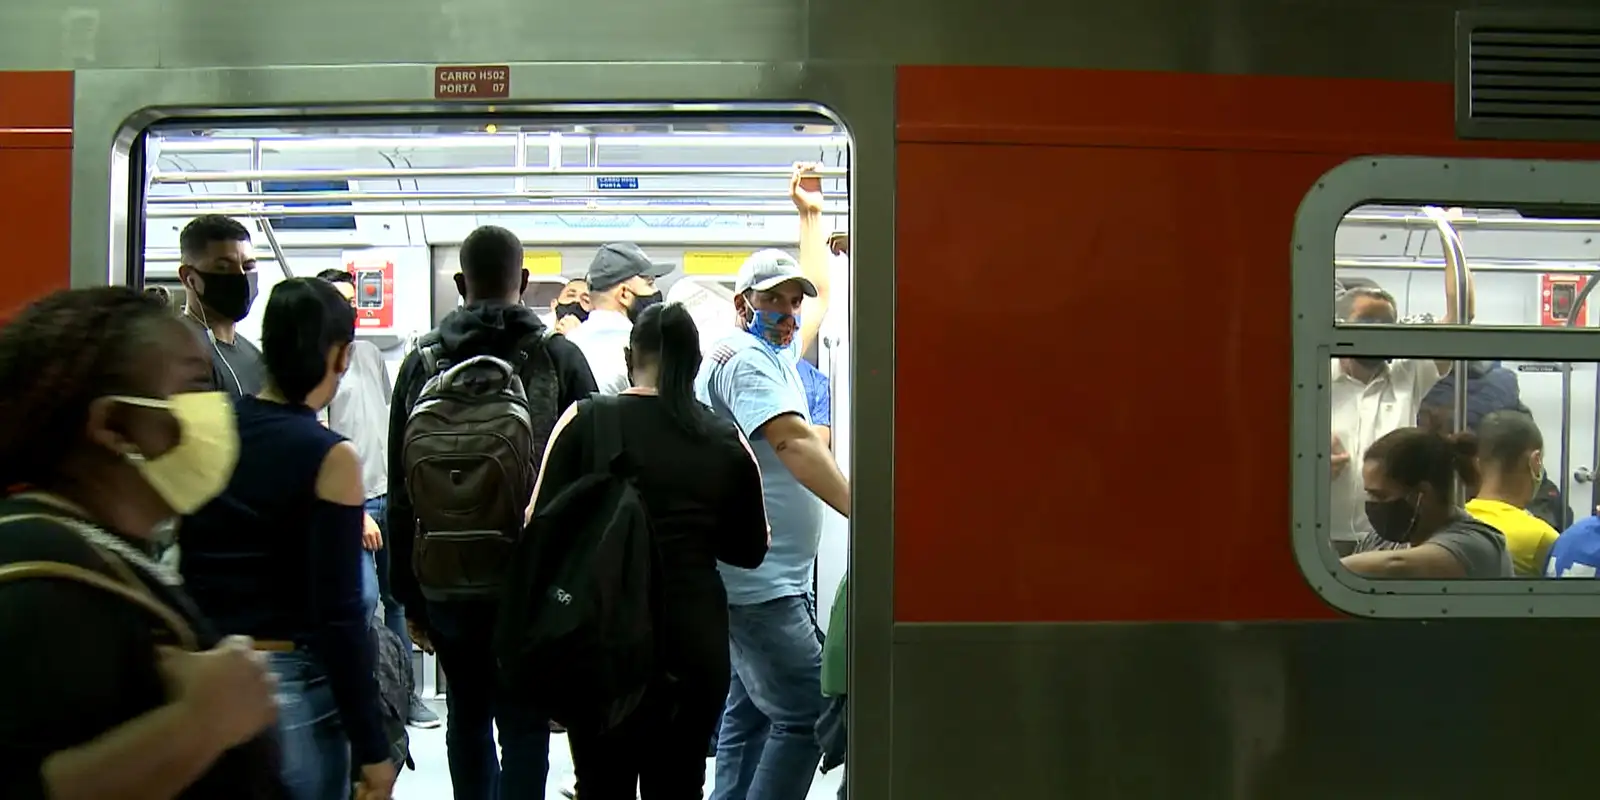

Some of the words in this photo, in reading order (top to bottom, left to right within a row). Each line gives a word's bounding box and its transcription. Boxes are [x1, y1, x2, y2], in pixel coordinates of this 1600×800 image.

[440, 71, 476, 81] CARRO
[479, 70, 505, 80] H502
[440, 83, 477, 93] PORTA
[492, 83, 505, 92] 07
